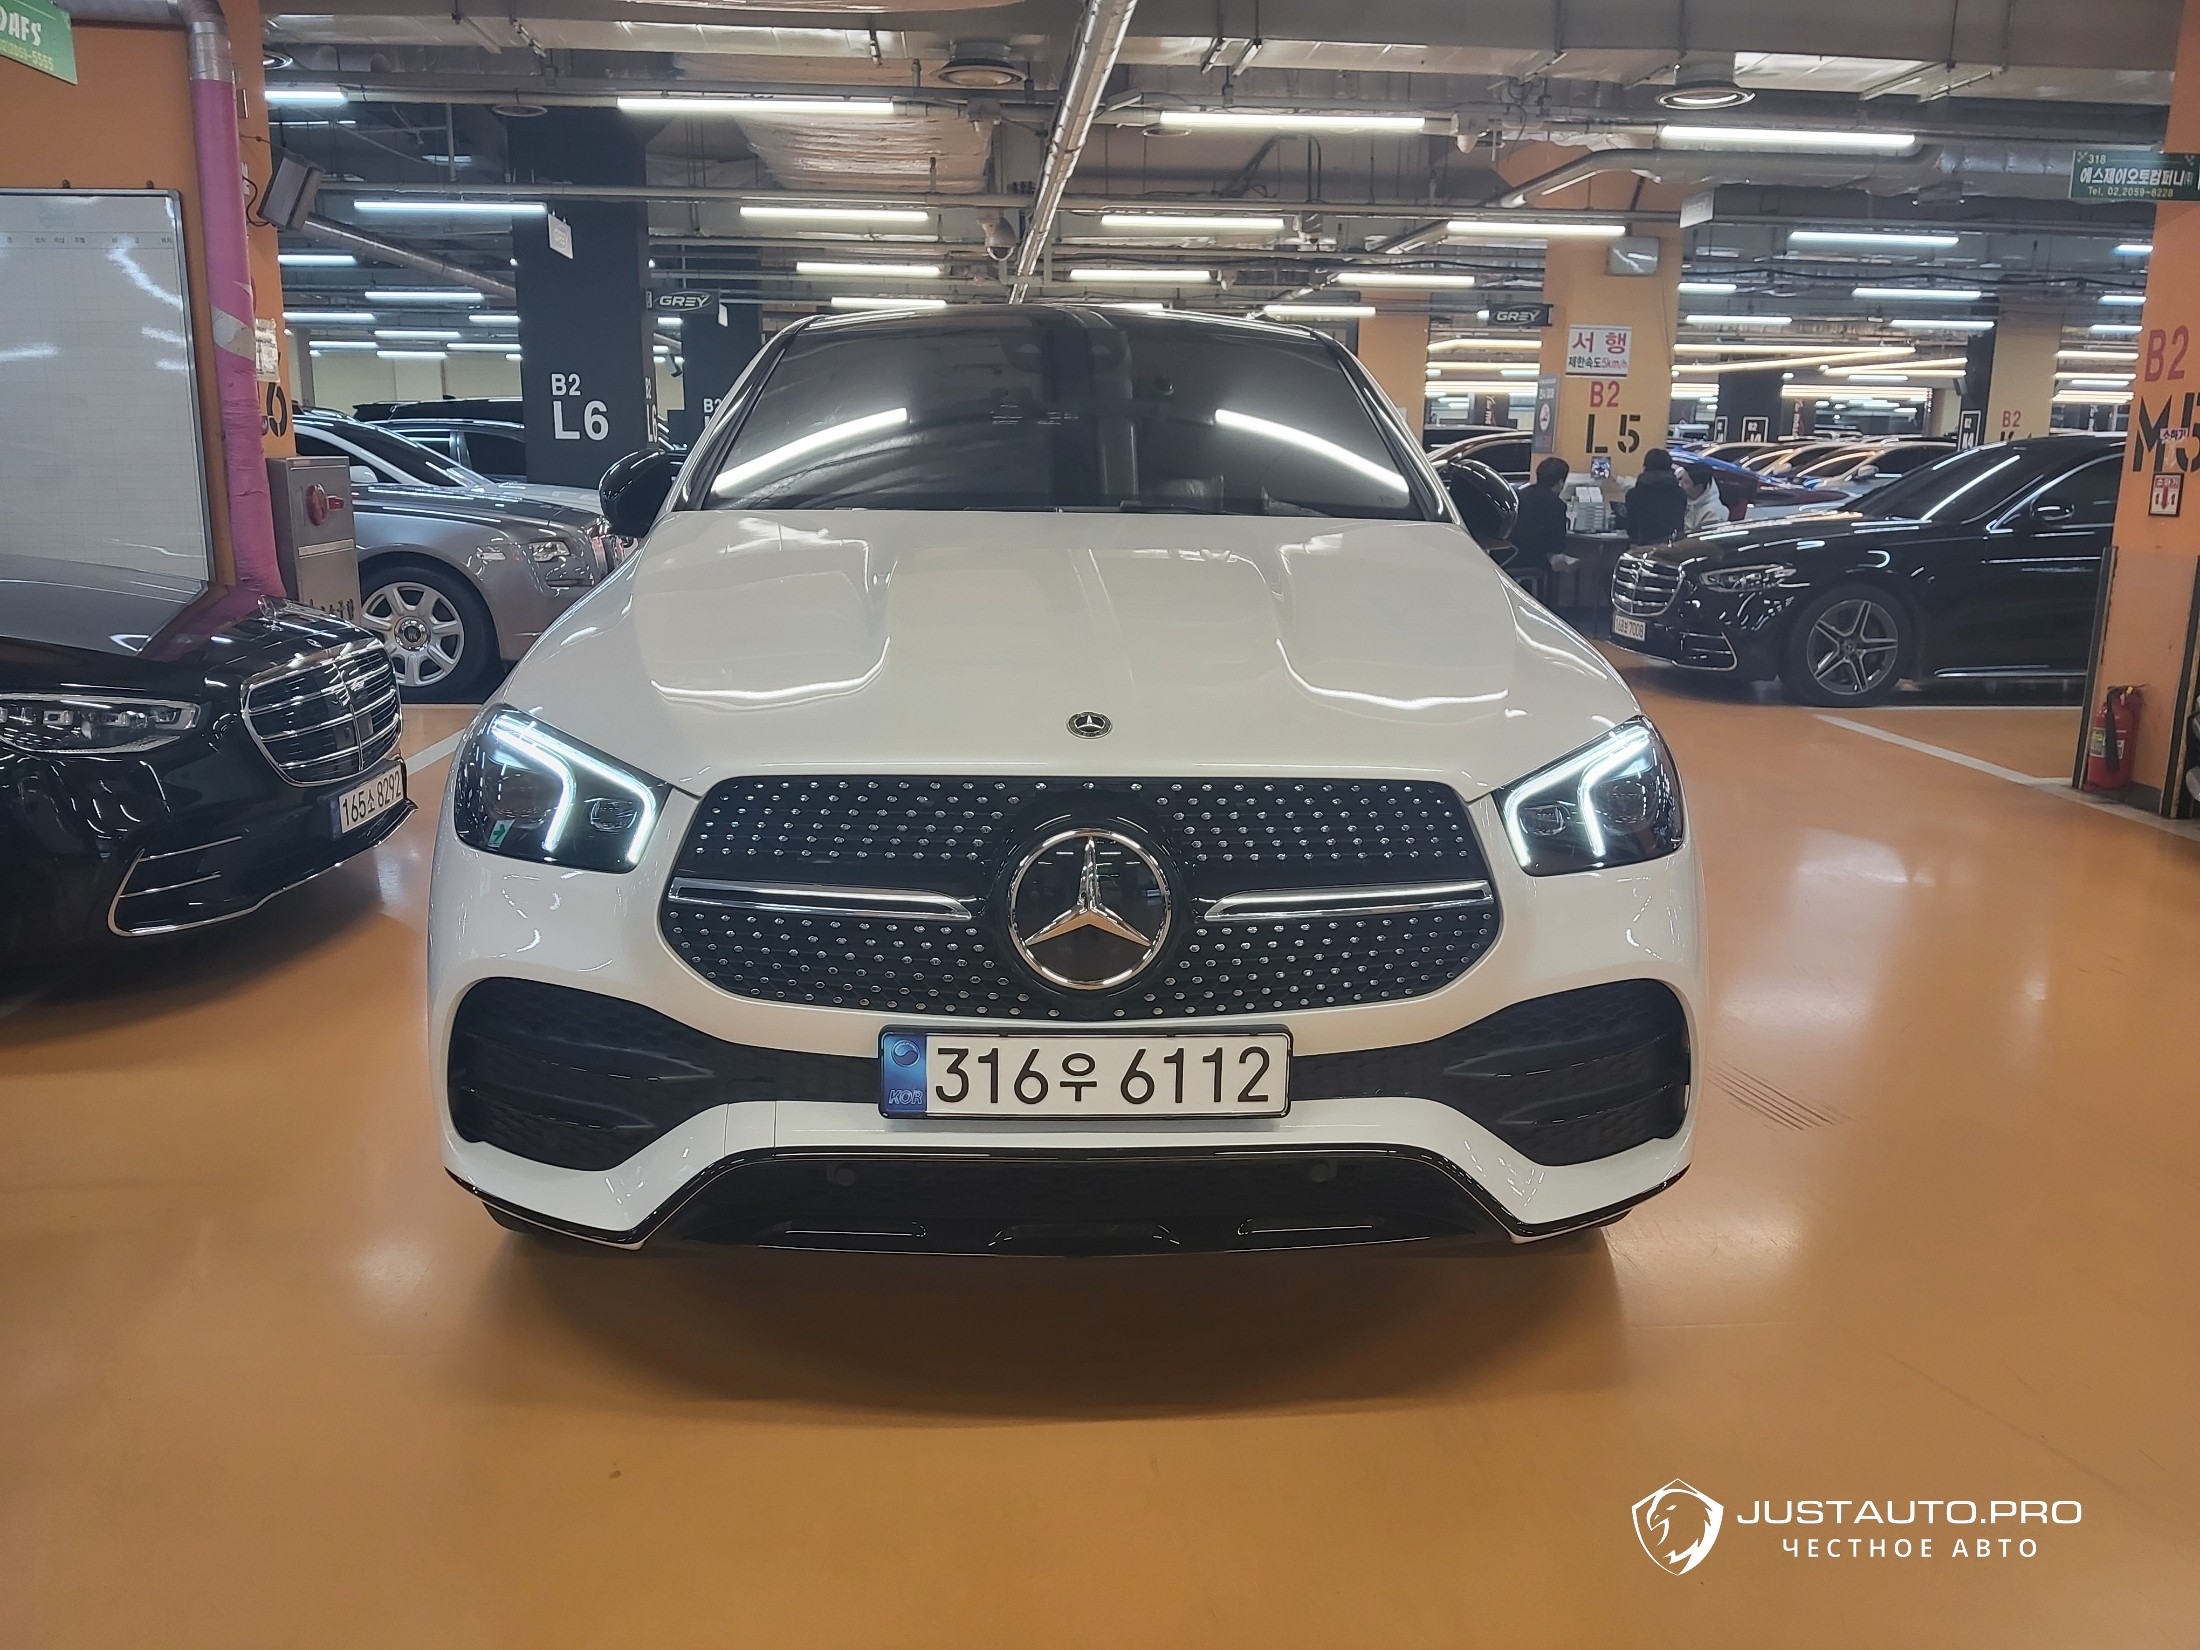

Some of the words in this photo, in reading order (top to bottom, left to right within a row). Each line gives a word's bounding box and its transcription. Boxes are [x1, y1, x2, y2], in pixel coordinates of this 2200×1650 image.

[2088, 154, 2106, 164] 318
[659, 294, 710, 307] GREY
[1496, 310, 1540, 321] GREY
[2144, 325, 2189, 381] B2
[551, 373, 581, 396] B2
[1590, 381, 1620, 407] B2
[553, 400, 609, 440] L6
[2002, 410, 2021, 427] B2
[2132, 391, 2200, 472] M5
[1585, 414, 1640, 453] L5
[343, 789, 375, 826] 165소
[377, 770, 401, 807] 8292
[935, 1047, 1097, 1104] 316우
[1120, 1046, 1271, 1105] 6112
[888, 1089, 924, 1105] KOR
